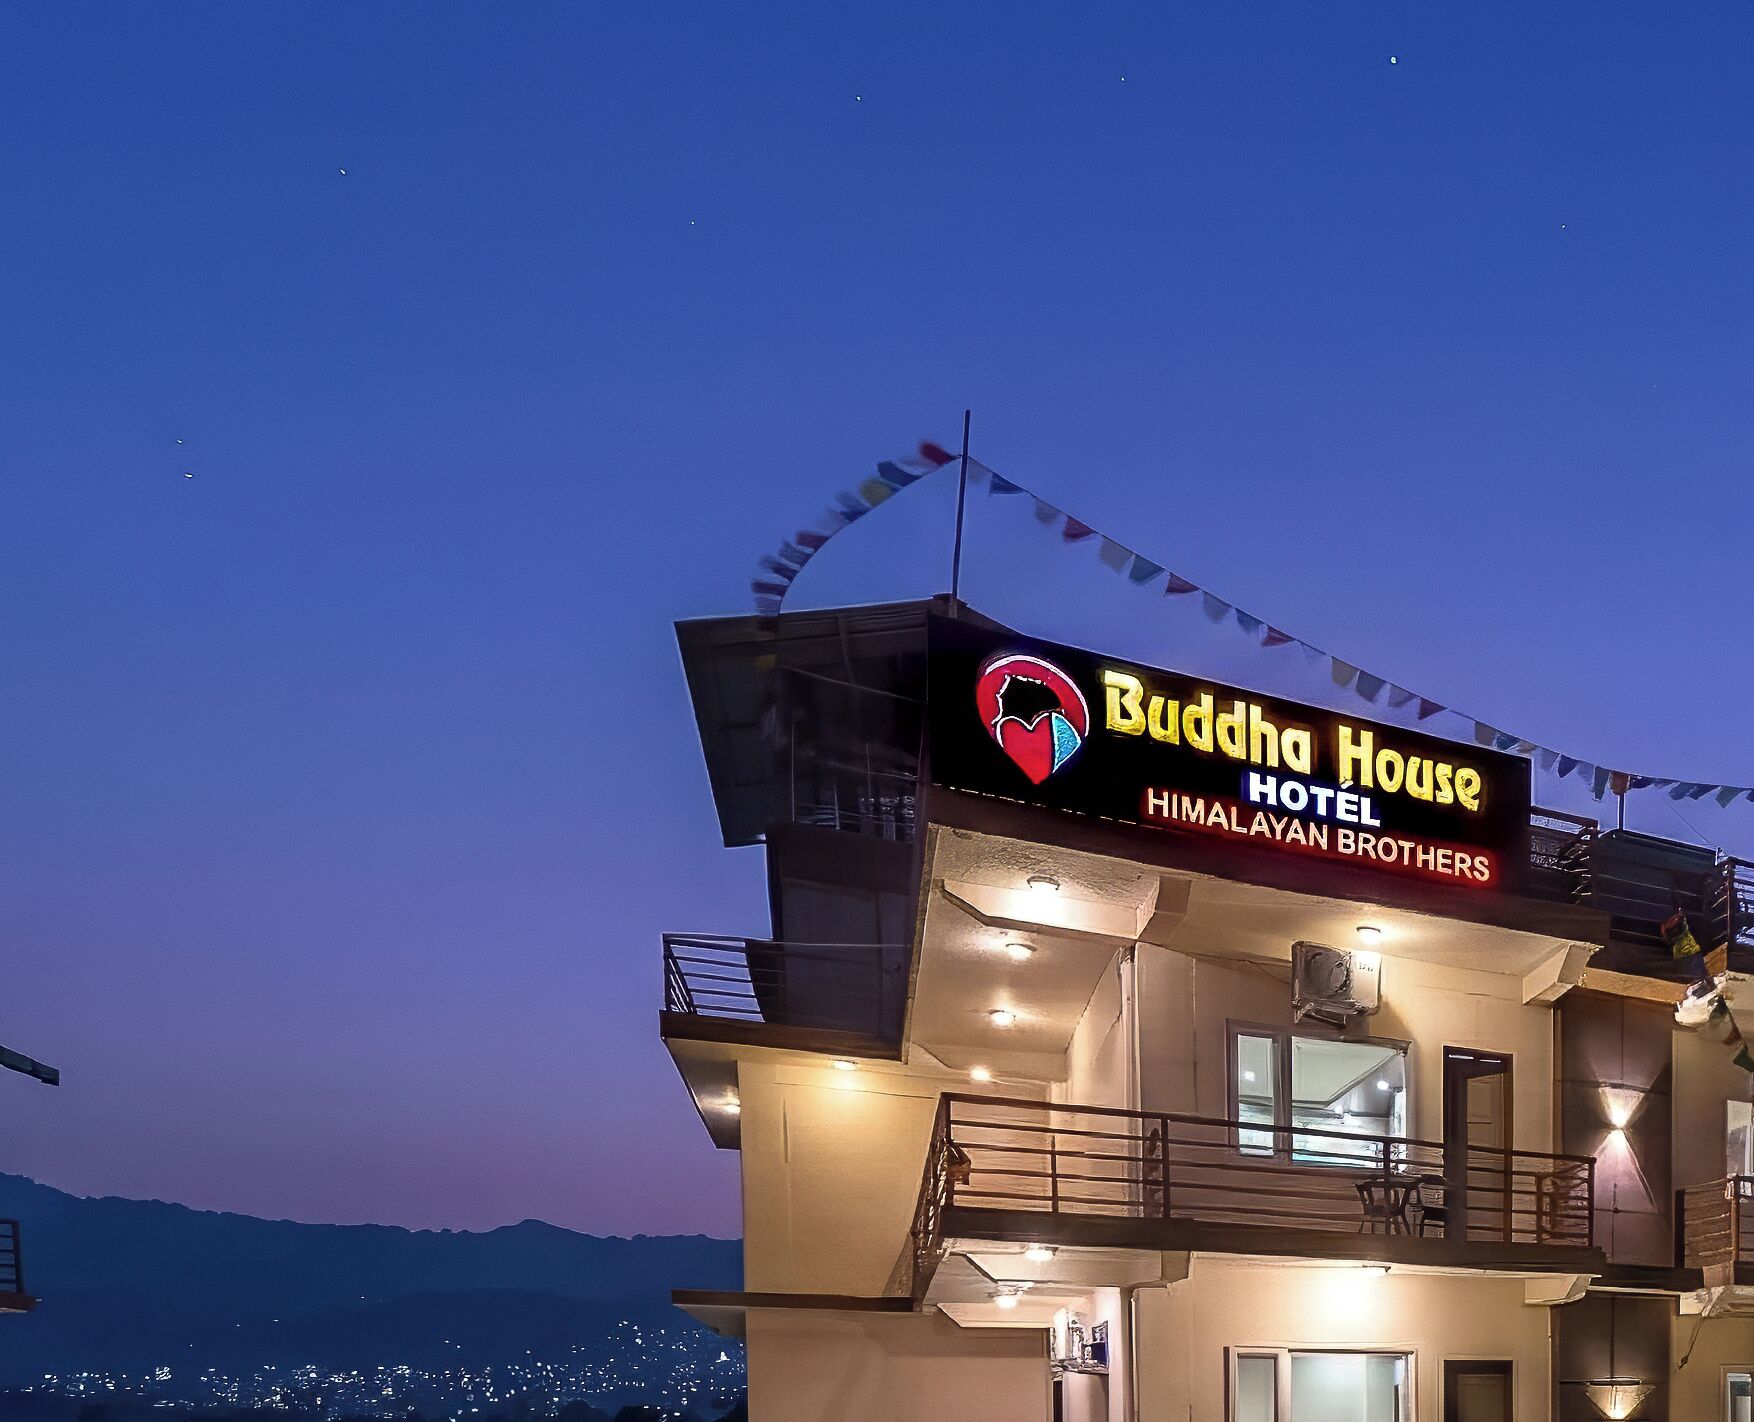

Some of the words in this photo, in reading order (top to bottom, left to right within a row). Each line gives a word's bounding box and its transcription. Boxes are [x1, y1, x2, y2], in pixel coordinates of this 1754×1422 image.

[1104, 670, 1311, 775] Buddha
[1339, 725, 1481, 812] House
[1147, 787, 1328, 850] HIMALAYAN
[1337, 828, 1490, 882] BROTHERS
